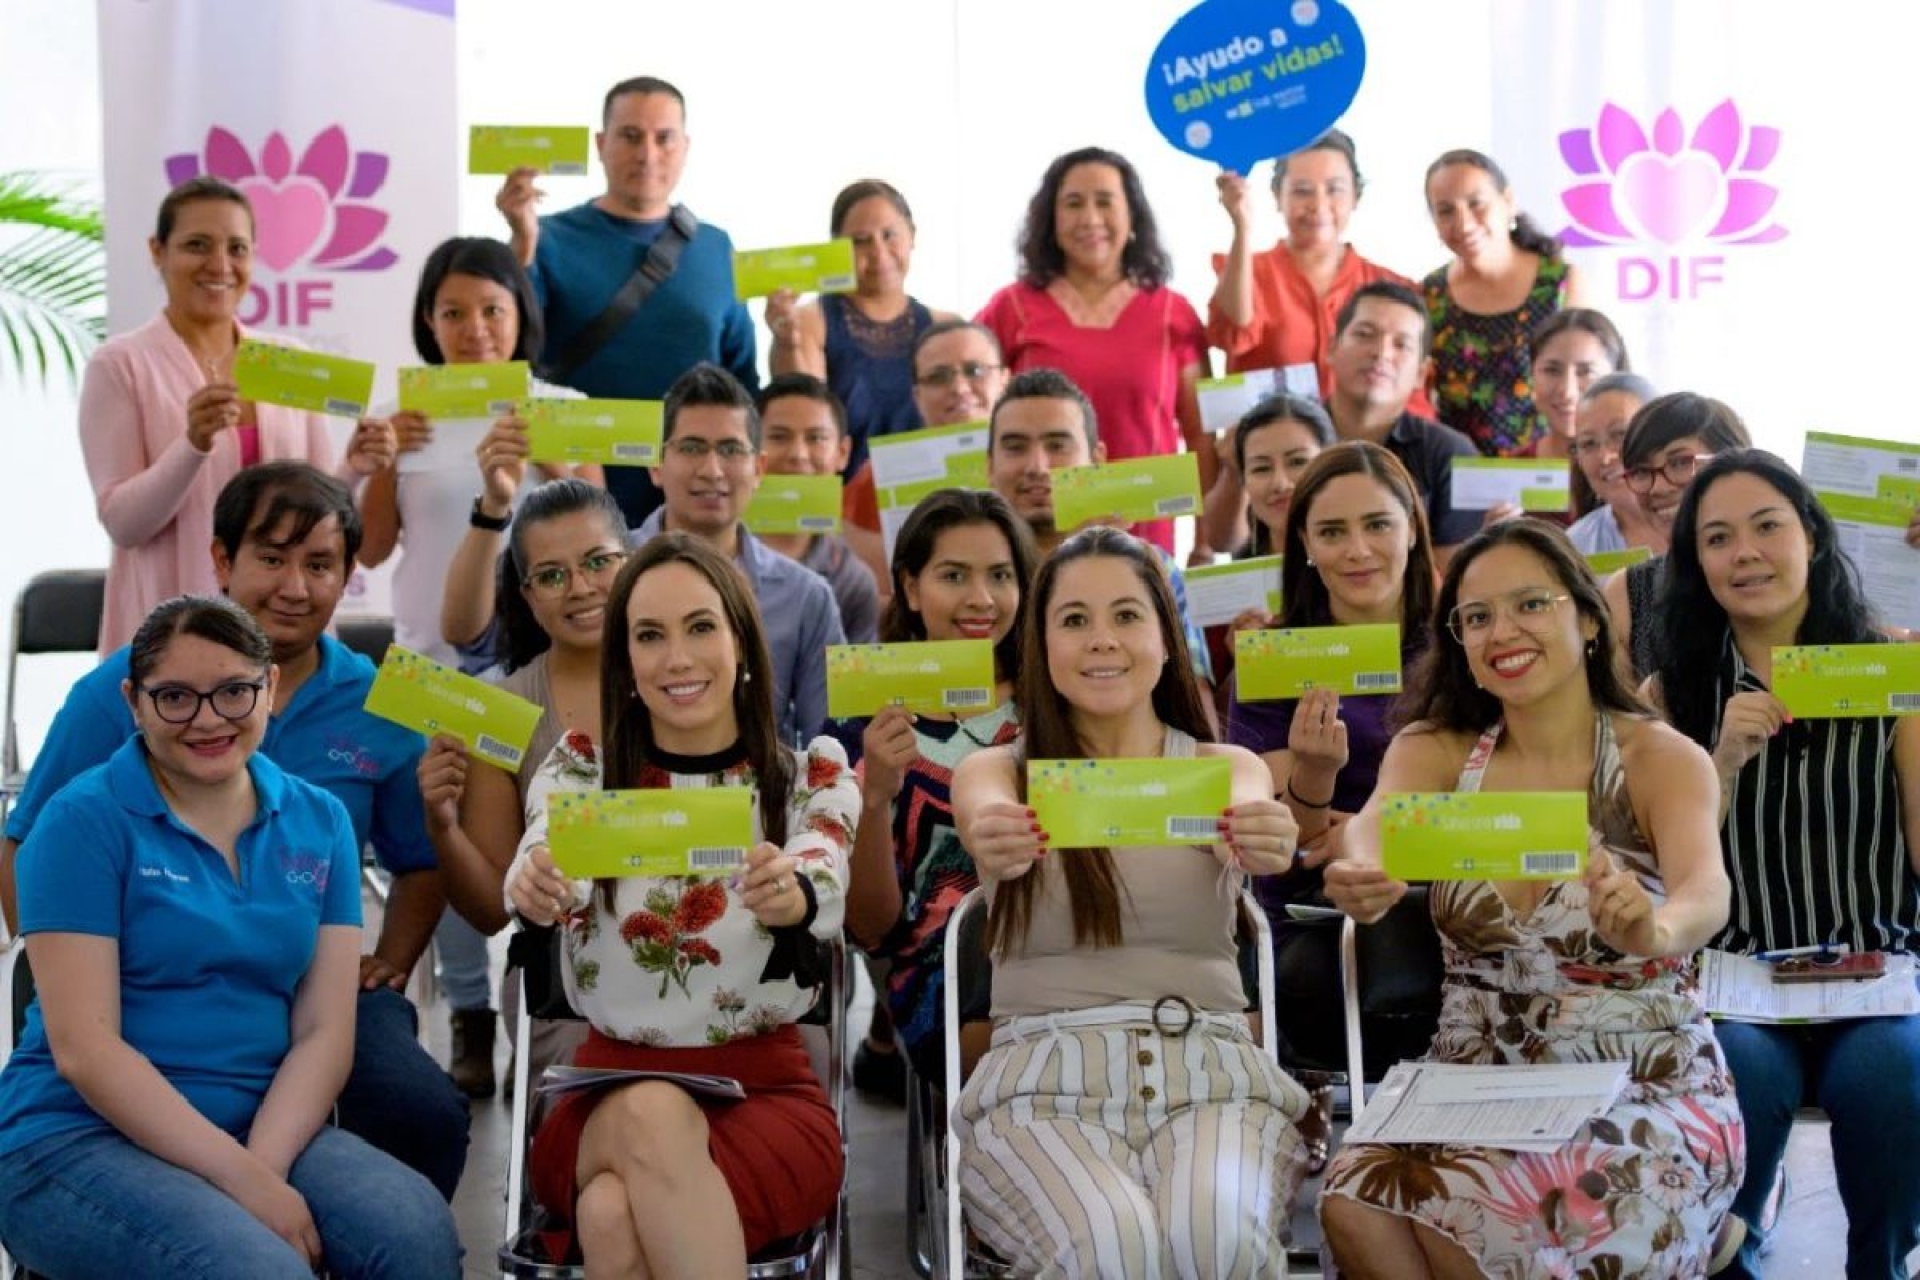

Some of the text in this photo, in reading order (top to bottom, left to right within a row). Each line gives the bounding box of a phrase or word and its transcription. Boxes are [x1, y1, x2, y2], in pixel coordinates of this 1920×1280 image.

[1162, 28, 1288, 86] ¡Ayudo a
[1172, 70, 1253, 114] salvar
[1261, 33, 1344, 81] vidas!
[239, 281, 333, 326] DIF
[1618, 256, 1725, 300] DIF
